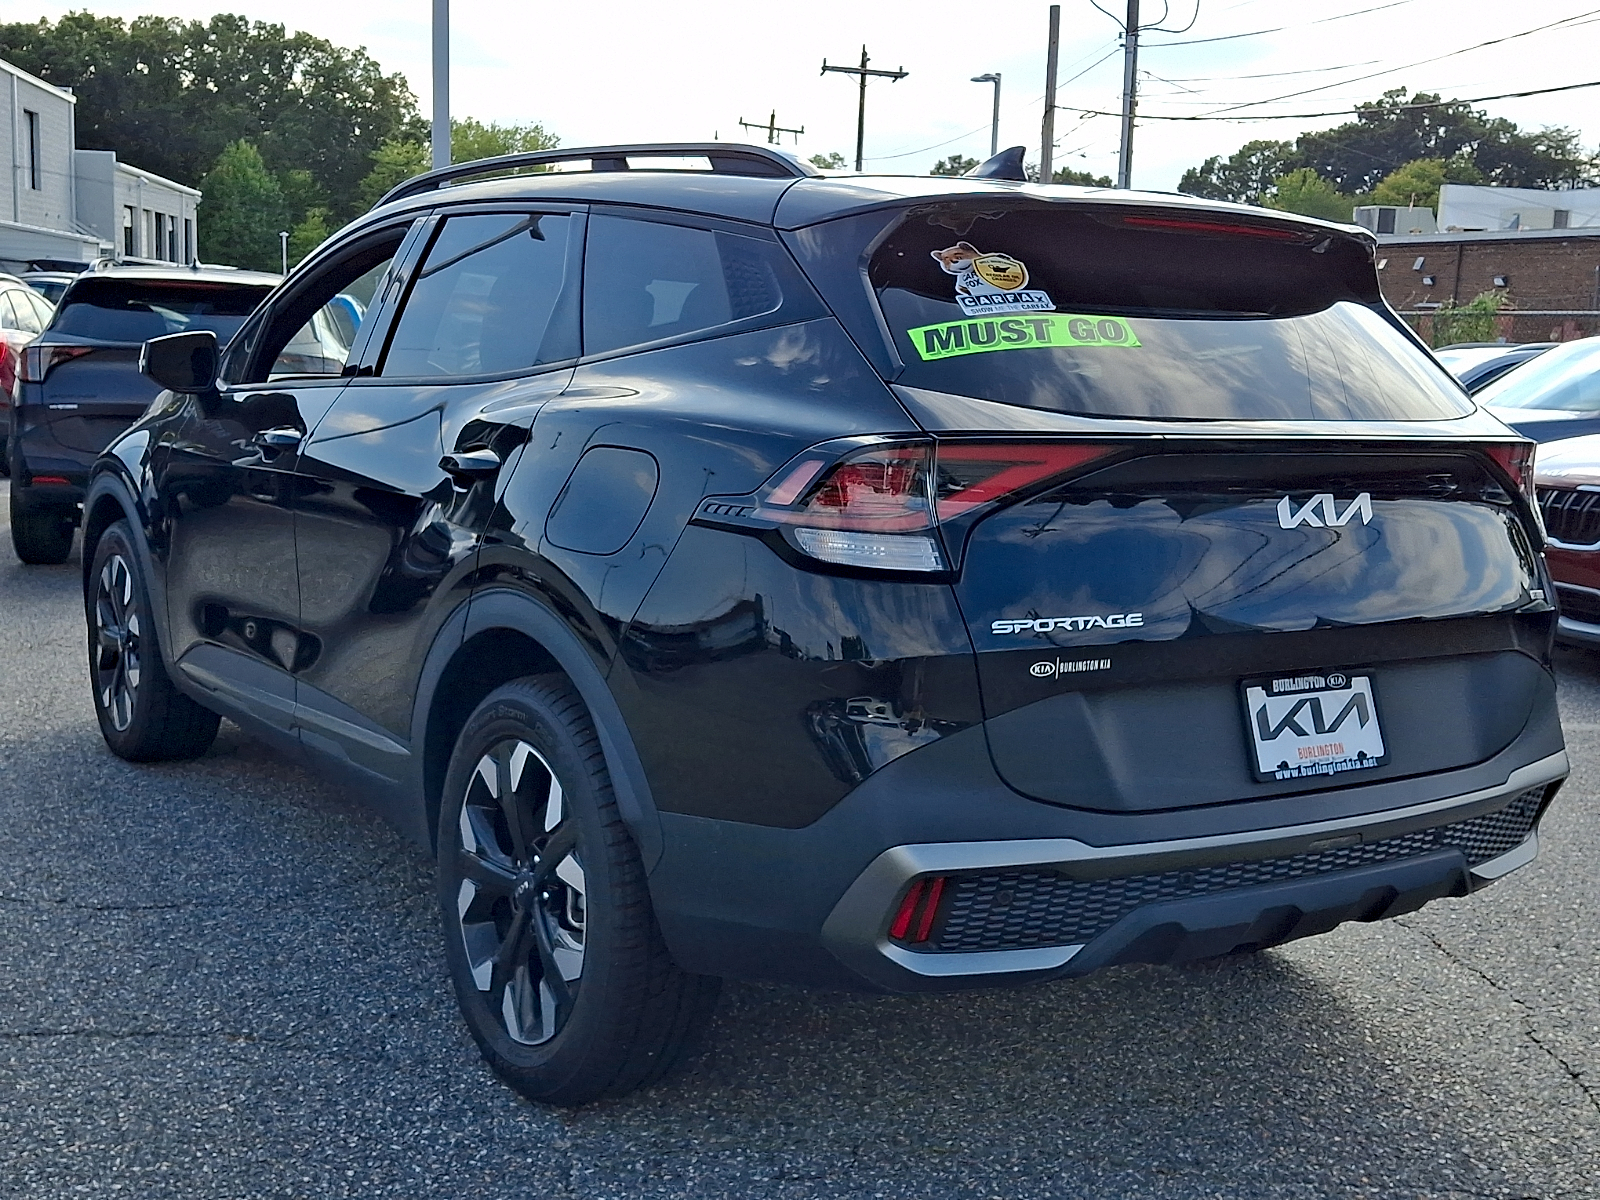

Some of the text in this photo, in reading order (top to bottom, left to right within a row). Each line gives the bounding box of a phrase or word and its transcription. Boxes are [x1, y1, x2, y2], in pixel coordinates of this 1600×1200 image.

[962, 292, 1045, 306] CARFAX
[970, 306, 994, 314] SHOW
[923, 318, 1129, 355] MUST GO
[1276, 492, 1374, 529] KIA
[991, 612, 1144, 635] SPORTAGE
[1060, 659, 1099, 673] BURLINGTON
[1100, 658, 1111, 670] KIA
[1272, 676, 1326, 693] BURLINGTON
[1256, 692, 1370, 741] KIA
[1297, 742, 1345, 759] BURLINGTON
[1275, 757, 1378, 780] www.burlingtonkia.net
